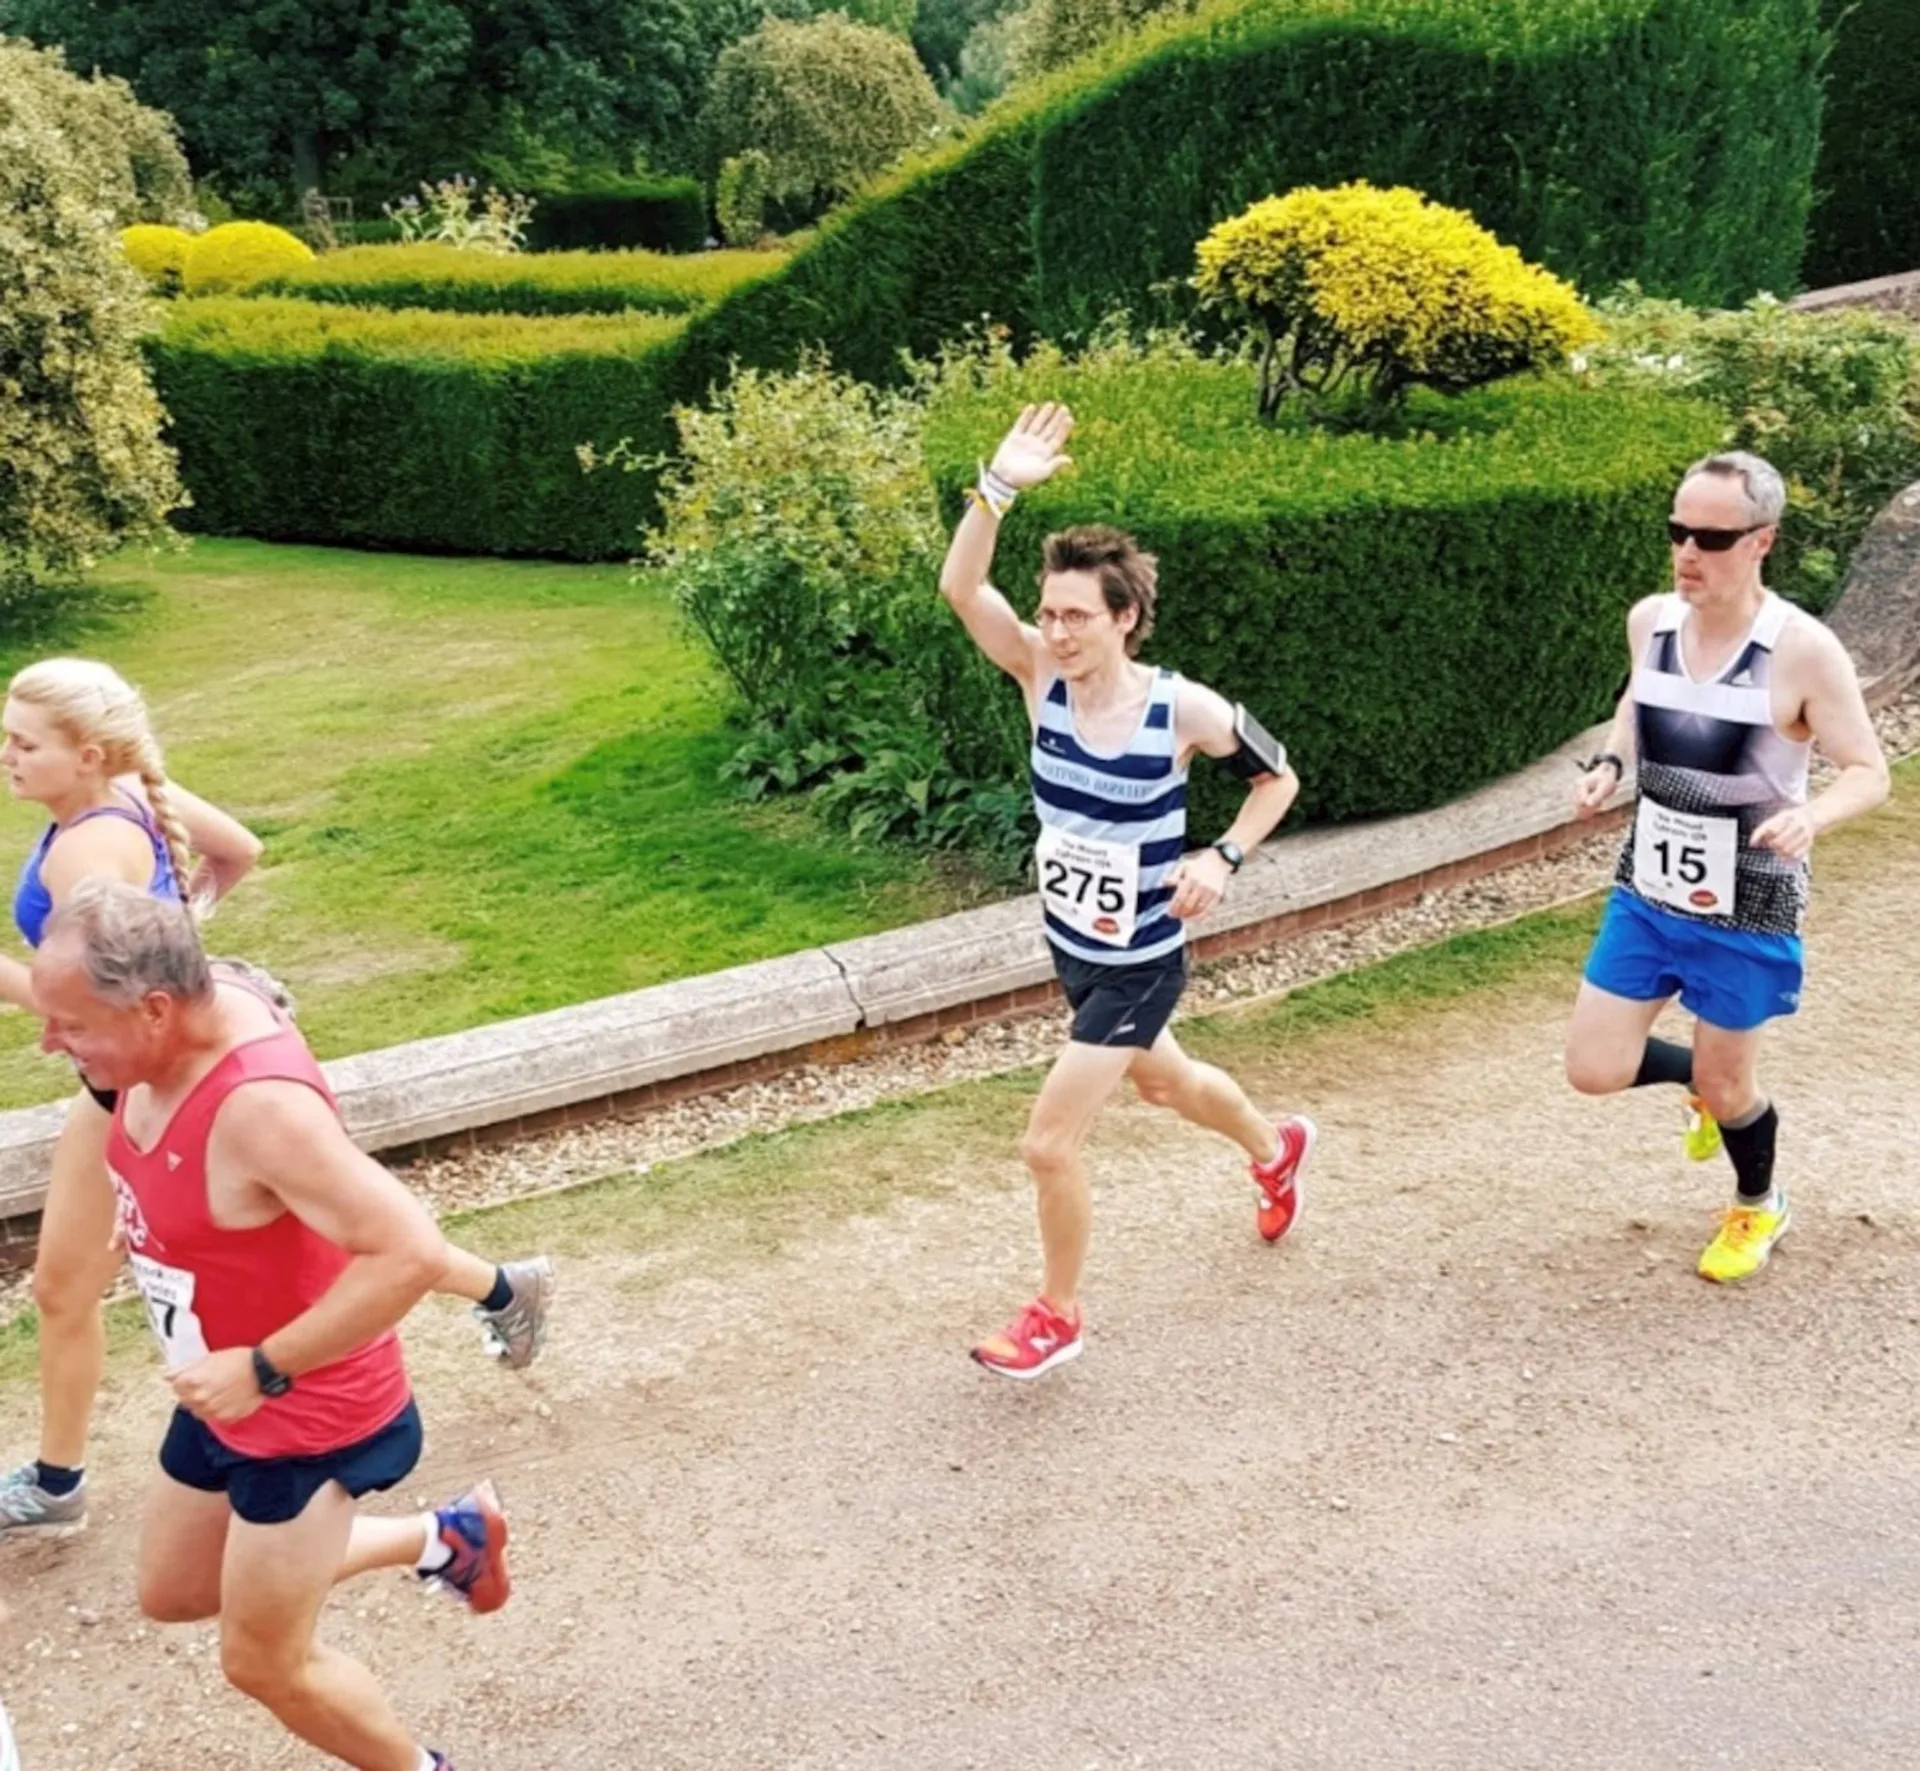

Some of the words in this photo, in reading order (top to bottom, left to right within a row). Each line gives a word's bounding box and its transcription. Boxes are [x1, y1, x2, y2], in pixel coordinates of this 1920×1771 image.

[1653, 839, 1707, 884] 15
[1044, 858, 1126, 914] 275
[149, 1296, 177, 1339] 7
